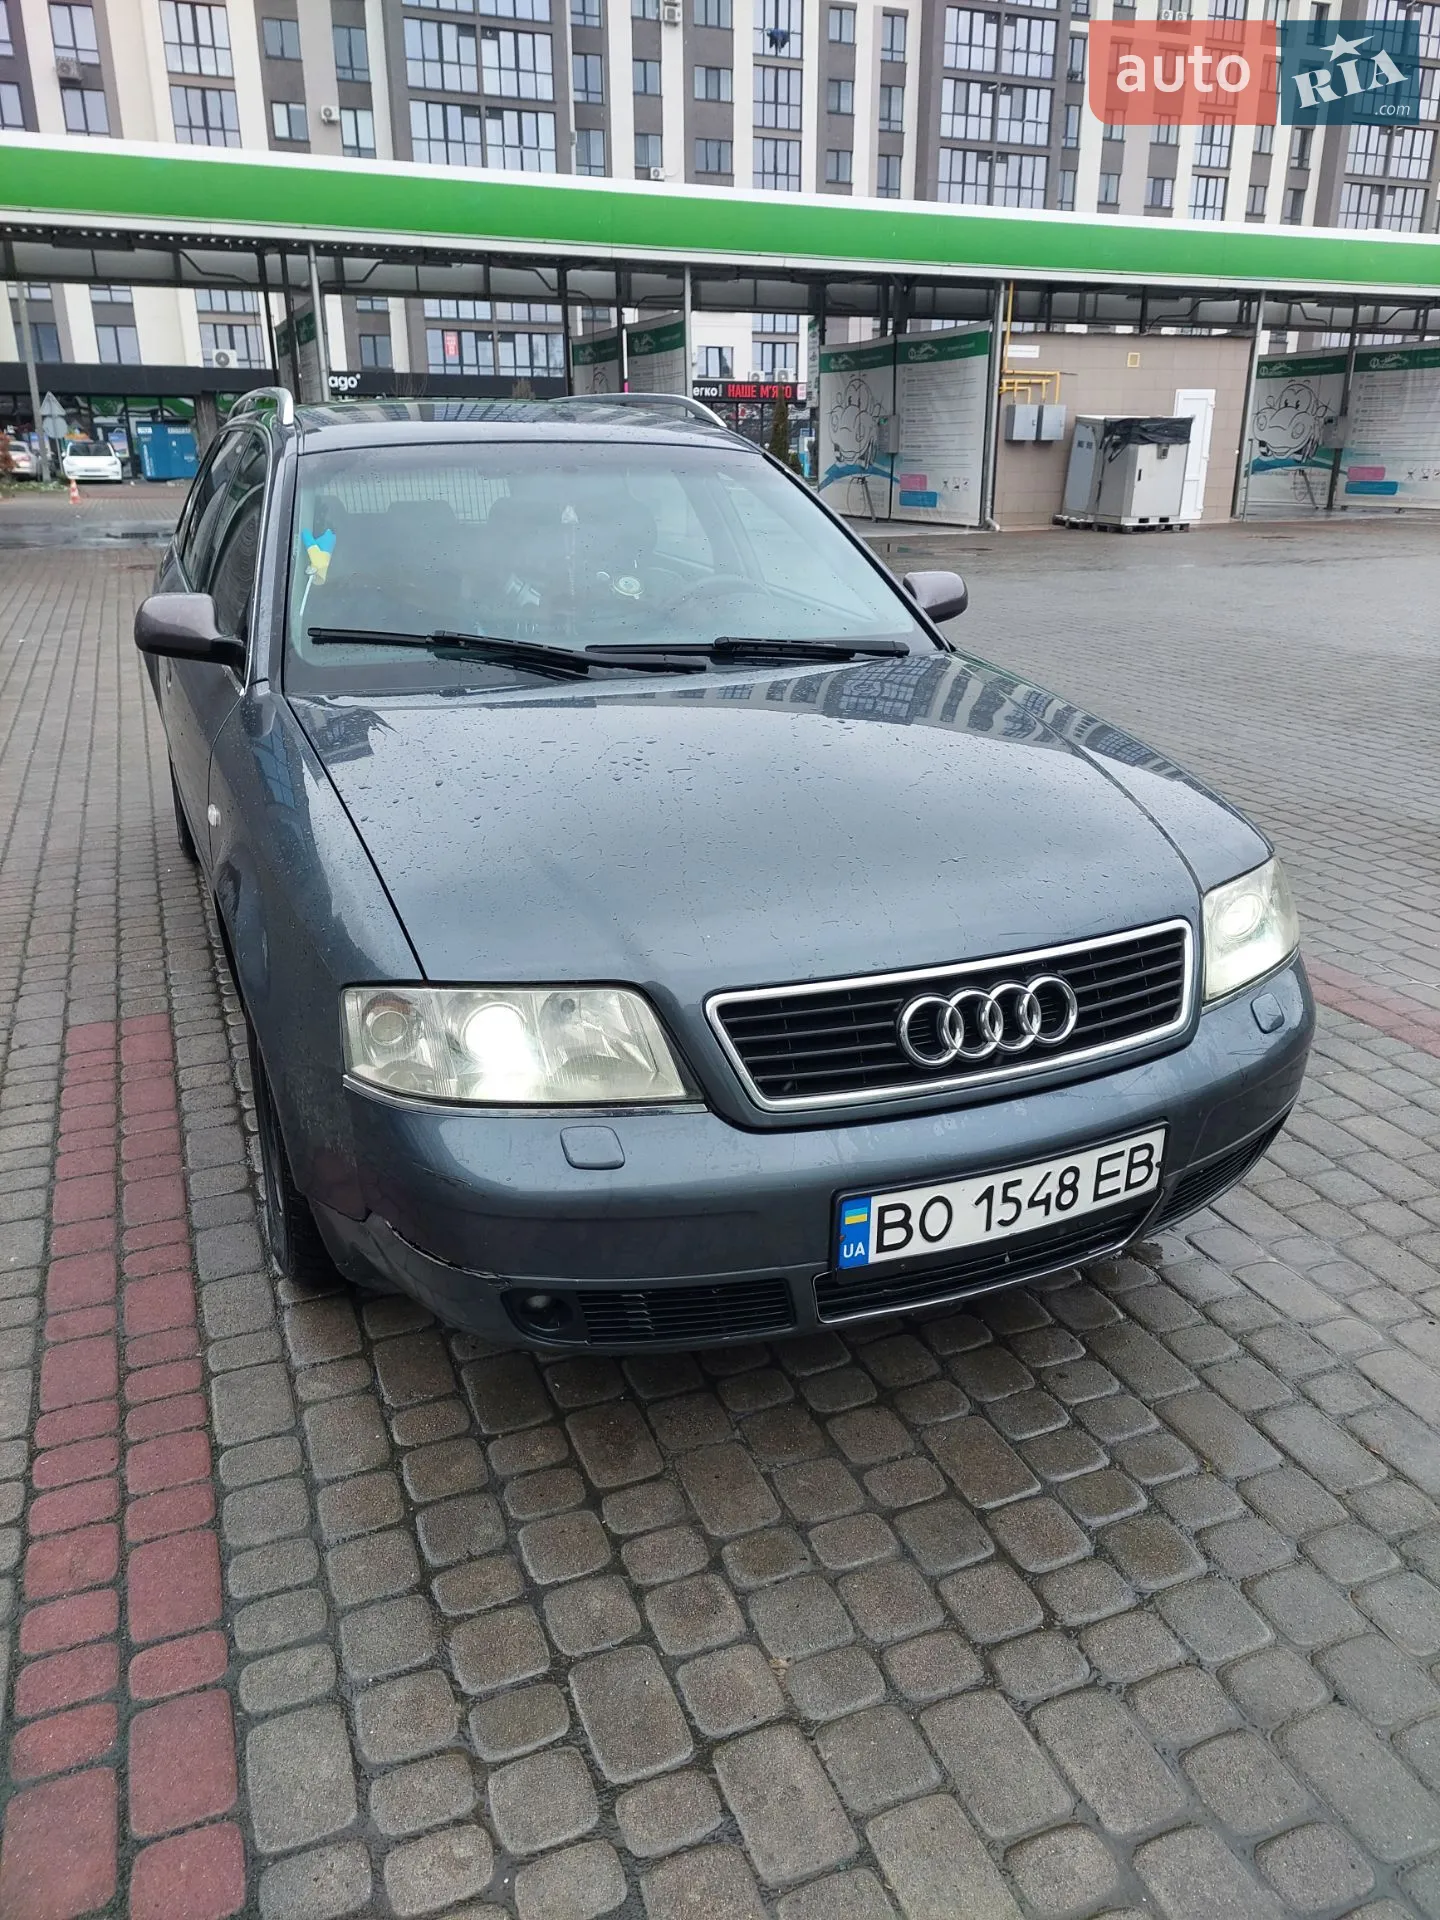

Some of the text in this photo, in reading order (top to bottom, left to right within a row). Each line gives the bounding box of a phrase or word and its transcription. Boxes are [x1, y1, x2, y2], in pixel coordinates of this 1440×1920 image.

[727, 384, 757, 398] НАШЕ
[760, 384, 792, 399] М'ЯО
[876, 1142, 1155, 1253] BO 1548 EB
[843, 1244, 866, 1259] UA
